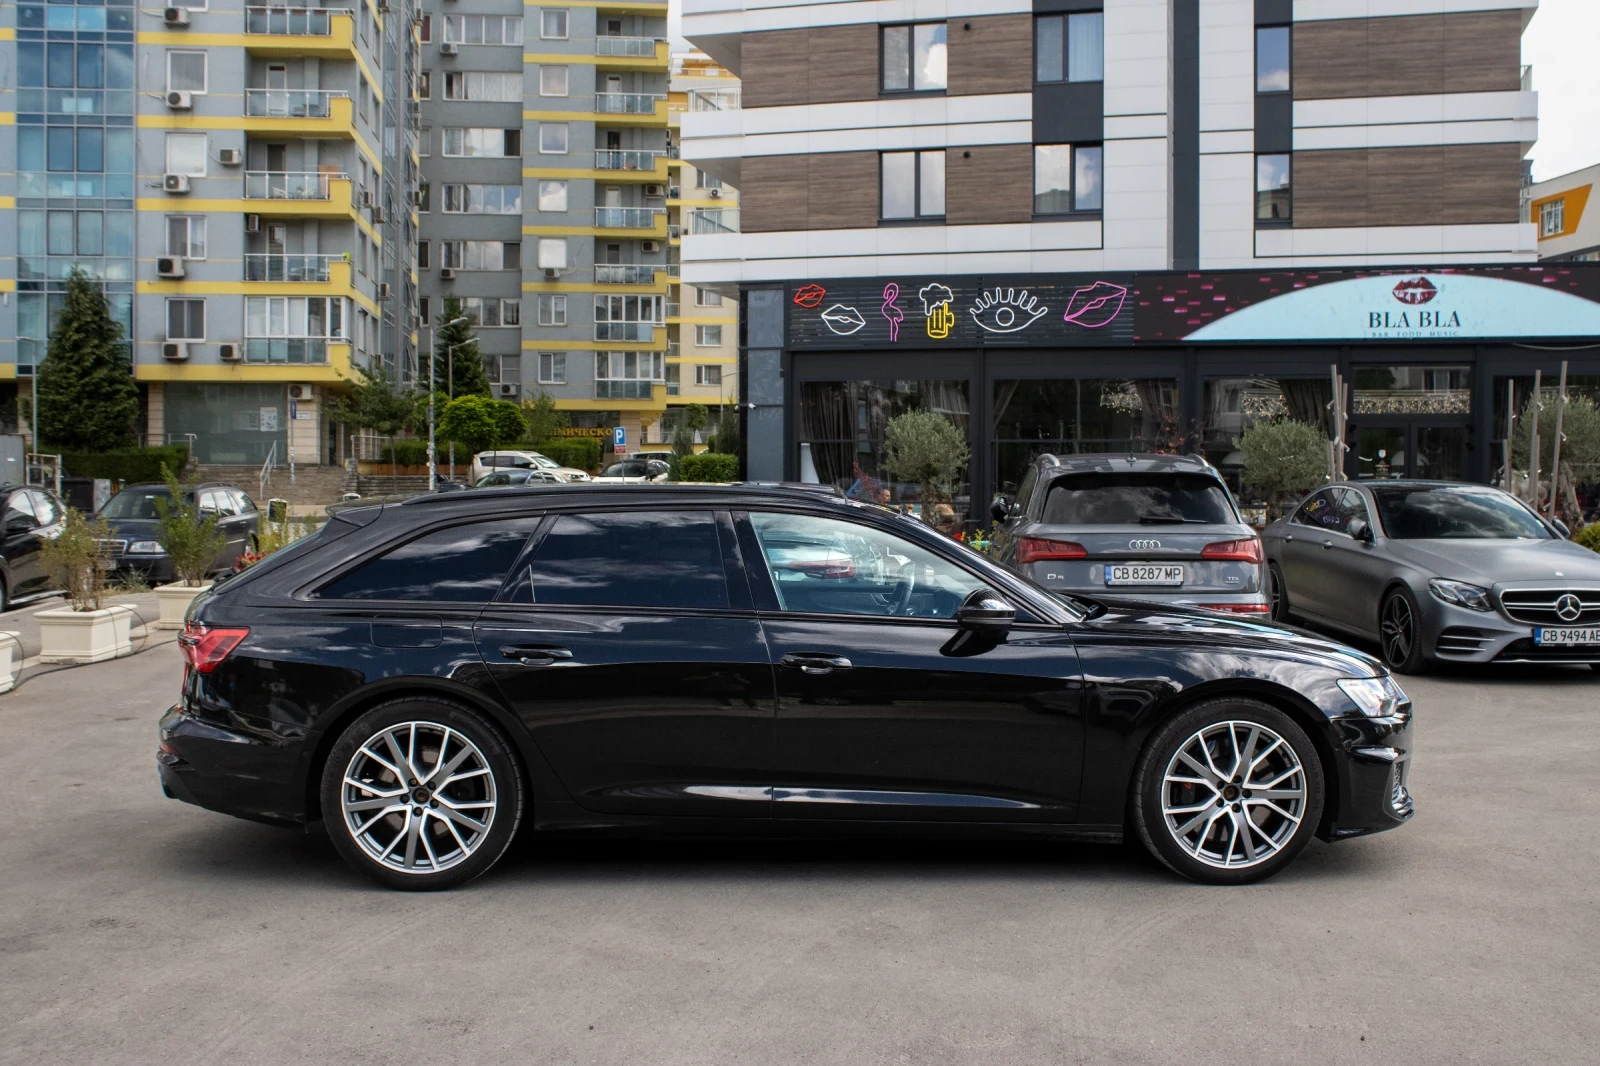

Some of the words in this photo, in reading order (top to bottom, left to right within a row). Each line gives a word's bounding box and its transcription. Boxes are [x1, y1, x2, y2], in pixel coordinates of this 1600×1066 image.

[1368, 311, 1410, 328] BLA
[1419, 310, 1461, 327] BLA
[615, 429, 623, 444] P
[1113, 567, 1130, 580] CB
[1132, 567, 1162, 580] 8287
[1164, 567, 1181, 580] MP
[1543, 630, 1558, 641] CB
[1560, 630, 1587, 641] 9494
